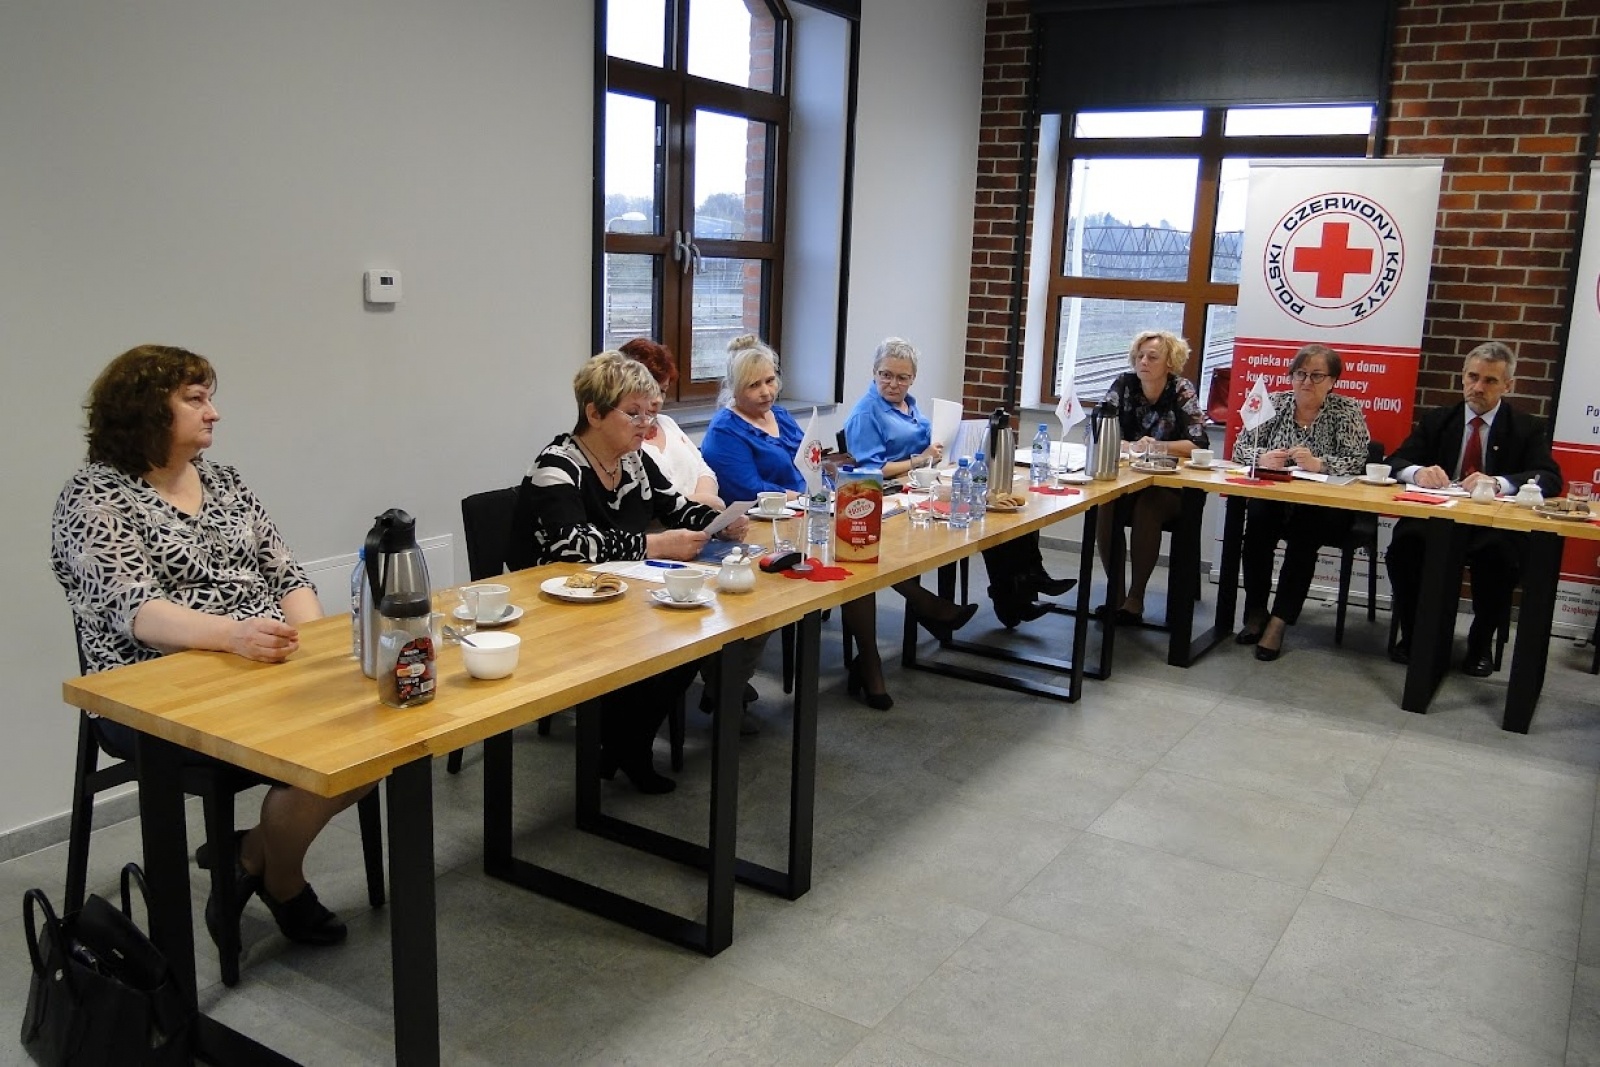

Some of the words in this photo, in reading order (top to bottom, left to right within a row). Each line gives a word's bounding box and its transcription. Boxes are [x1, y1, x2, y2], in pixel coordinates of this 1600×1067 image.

[1283, 197, 1397, 241] CZERWONY
[1269, 244, 1305, 315] POLSKI
[1351, 251, 1399, 318] KRZYŻ
[1248, 353, 1281, 368] opieka
[1345, 362, 1355, 372] w
[1356, 360, 1386, 374] domu
[1373, 396, 1402, 414] (HDK)
